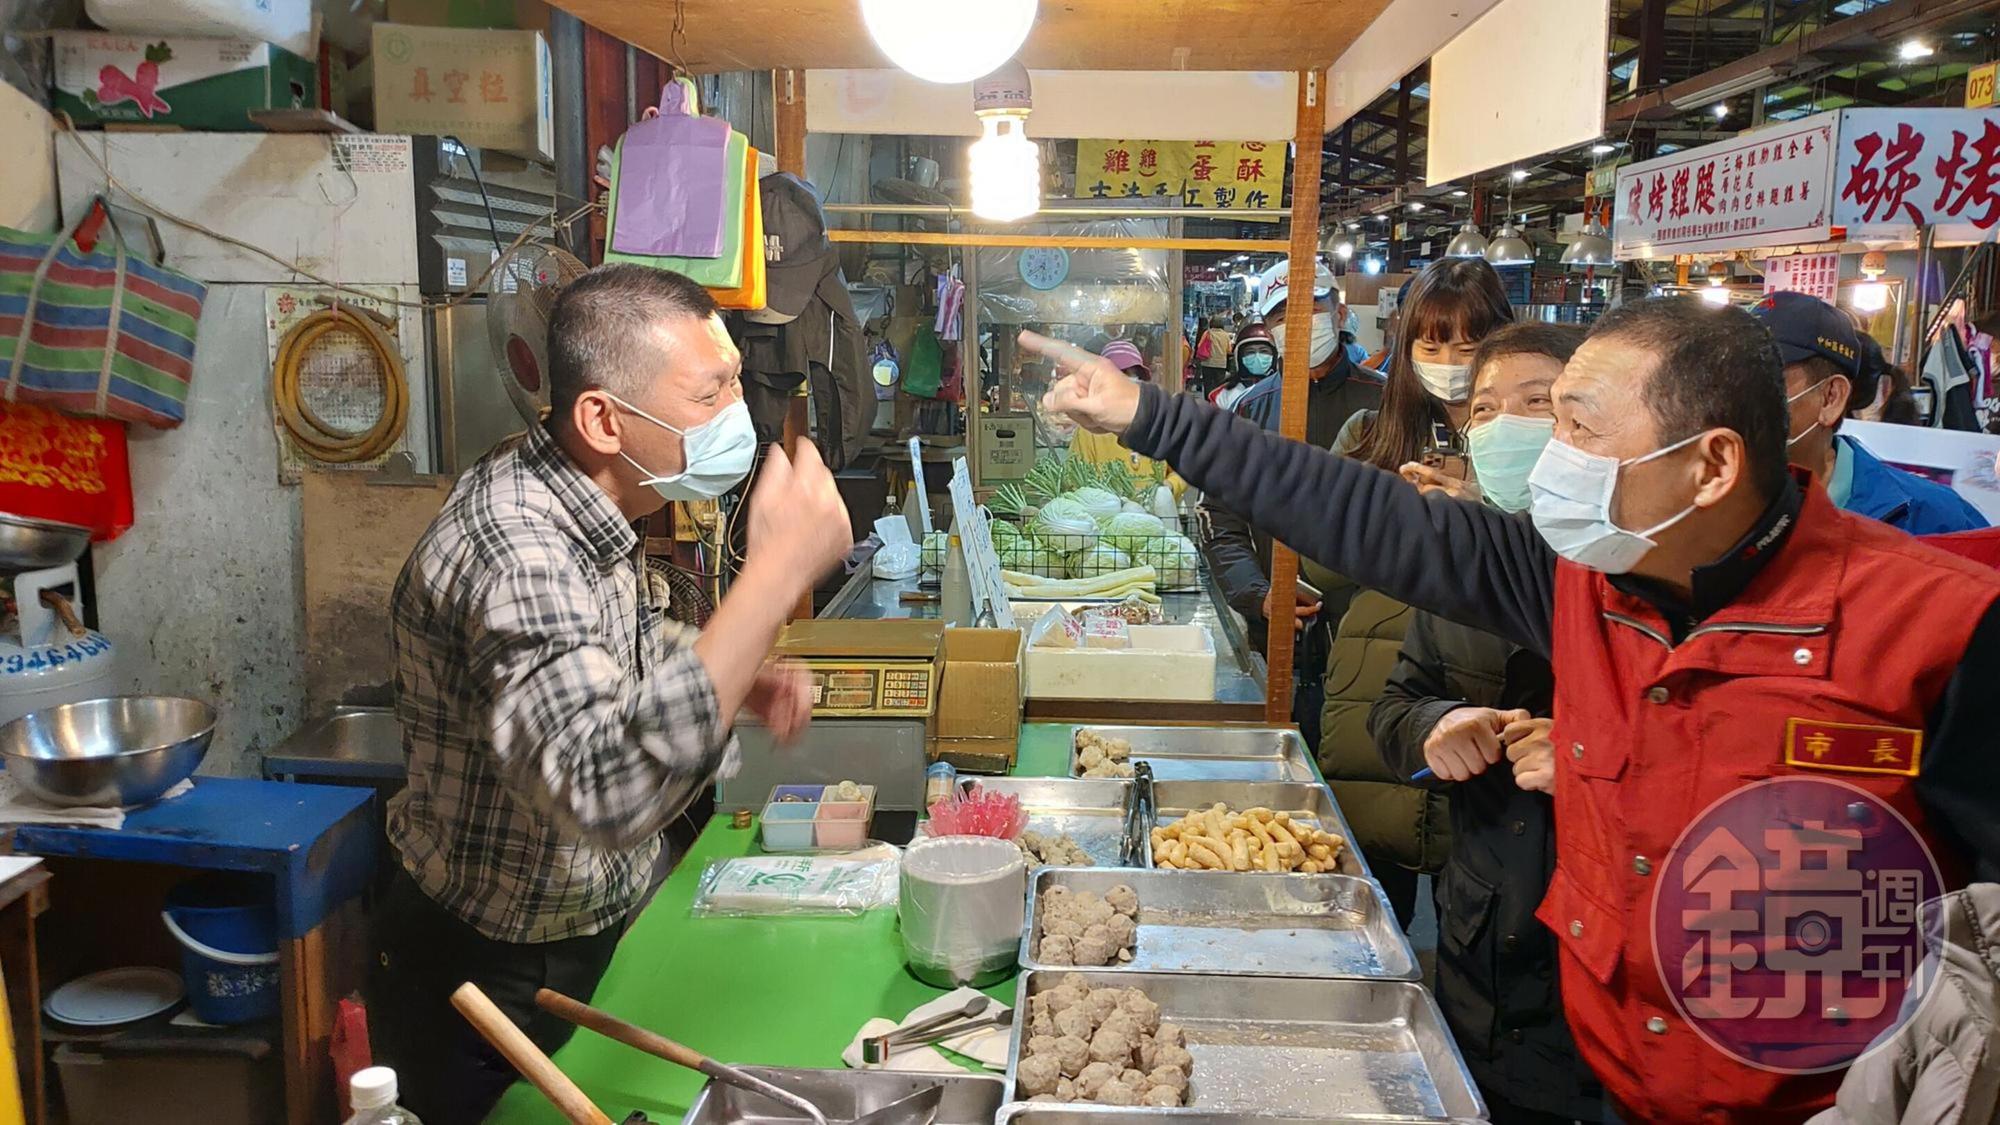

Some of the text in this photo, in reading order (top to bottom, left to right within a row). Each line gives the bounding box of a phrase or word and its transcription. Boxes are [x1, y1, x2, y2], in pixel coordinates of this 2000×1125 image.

[1970, 74, 1993, 100] 073
[1103, 140, 1130, 175] 雞
[1803, 732, 1903, 763] 市長
